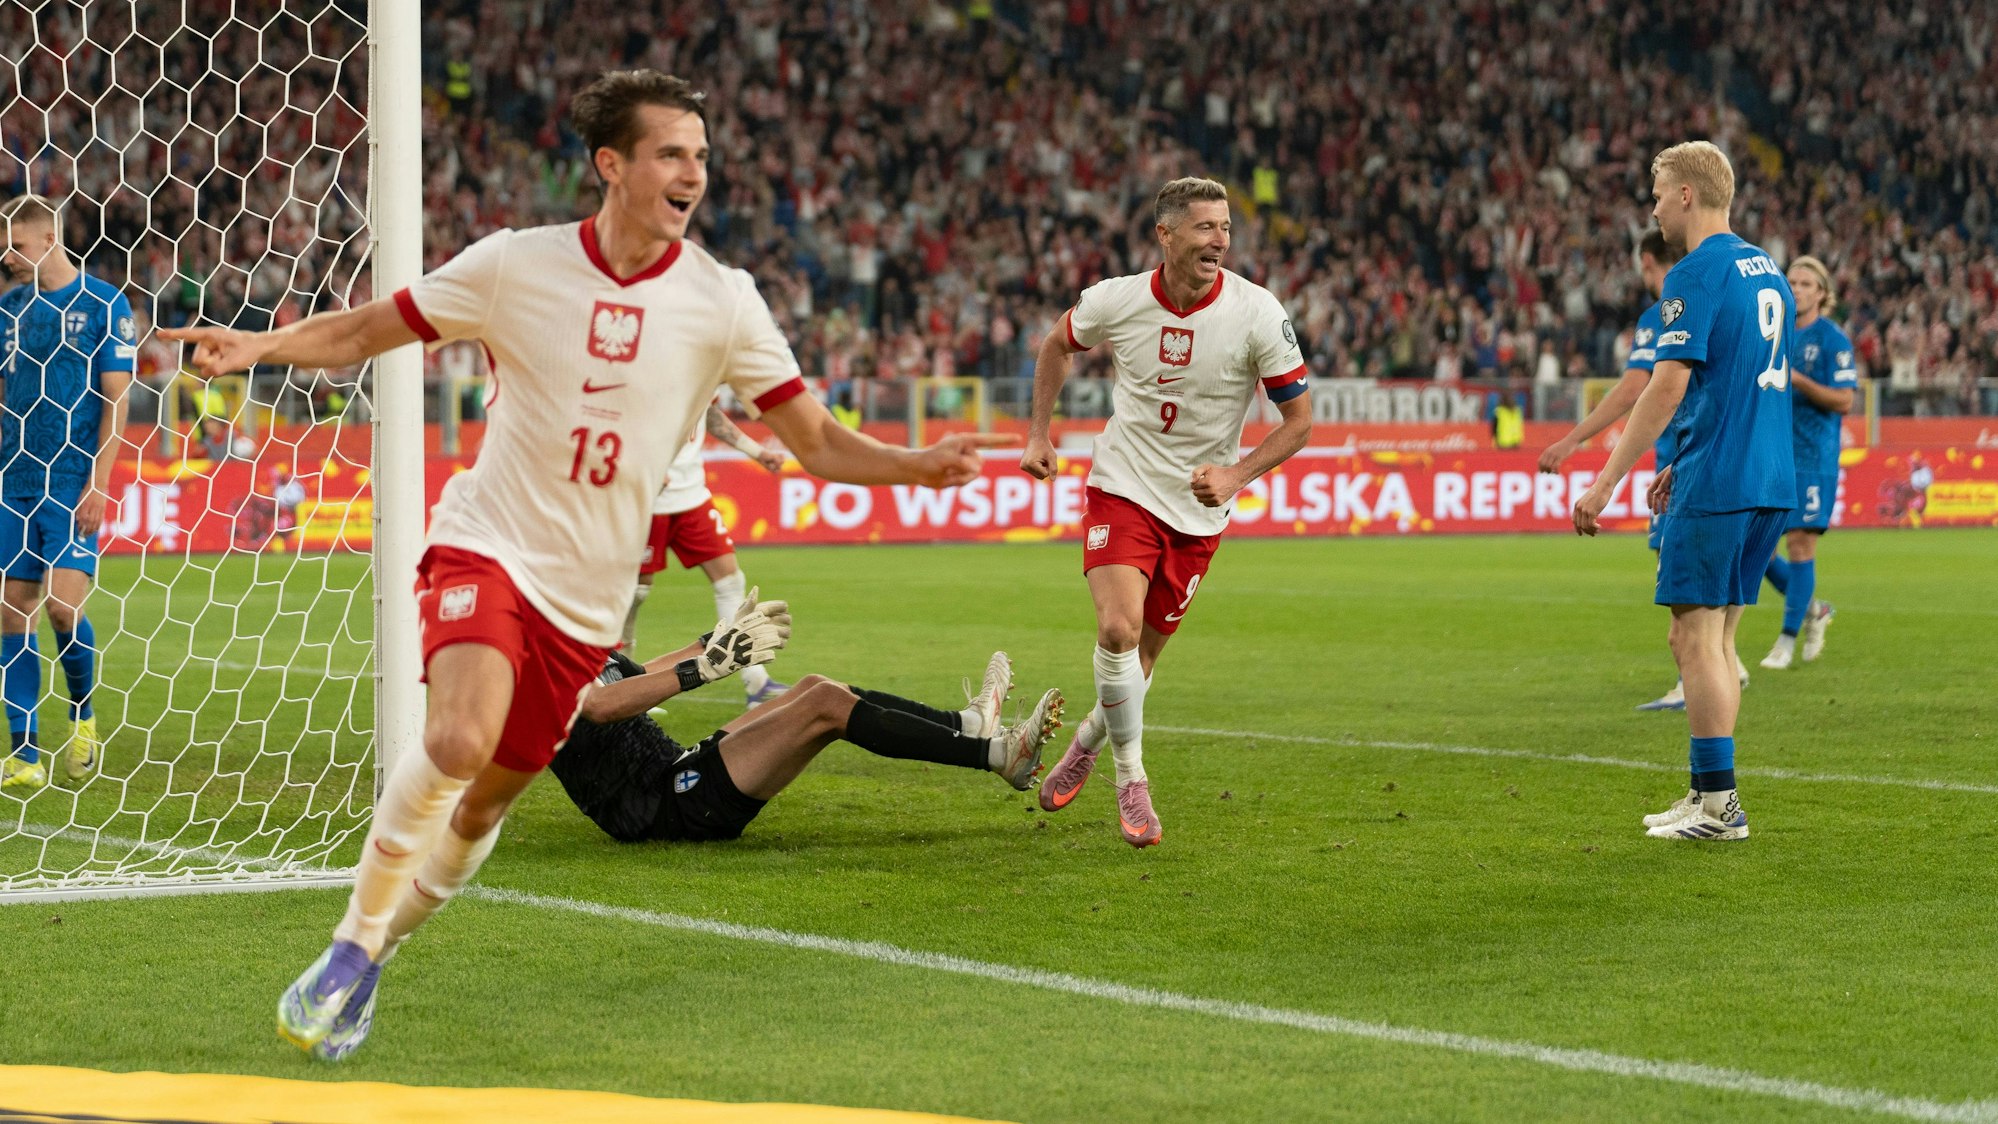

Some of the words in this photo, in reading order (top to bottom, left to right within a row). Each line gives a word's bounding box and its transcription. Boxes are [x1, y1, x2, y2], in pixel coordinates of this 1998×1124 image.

[1160, 401, 1179, 434] 9
[568, 425, 623, 489] 13
[1178, 573, 1201, 610] 9
